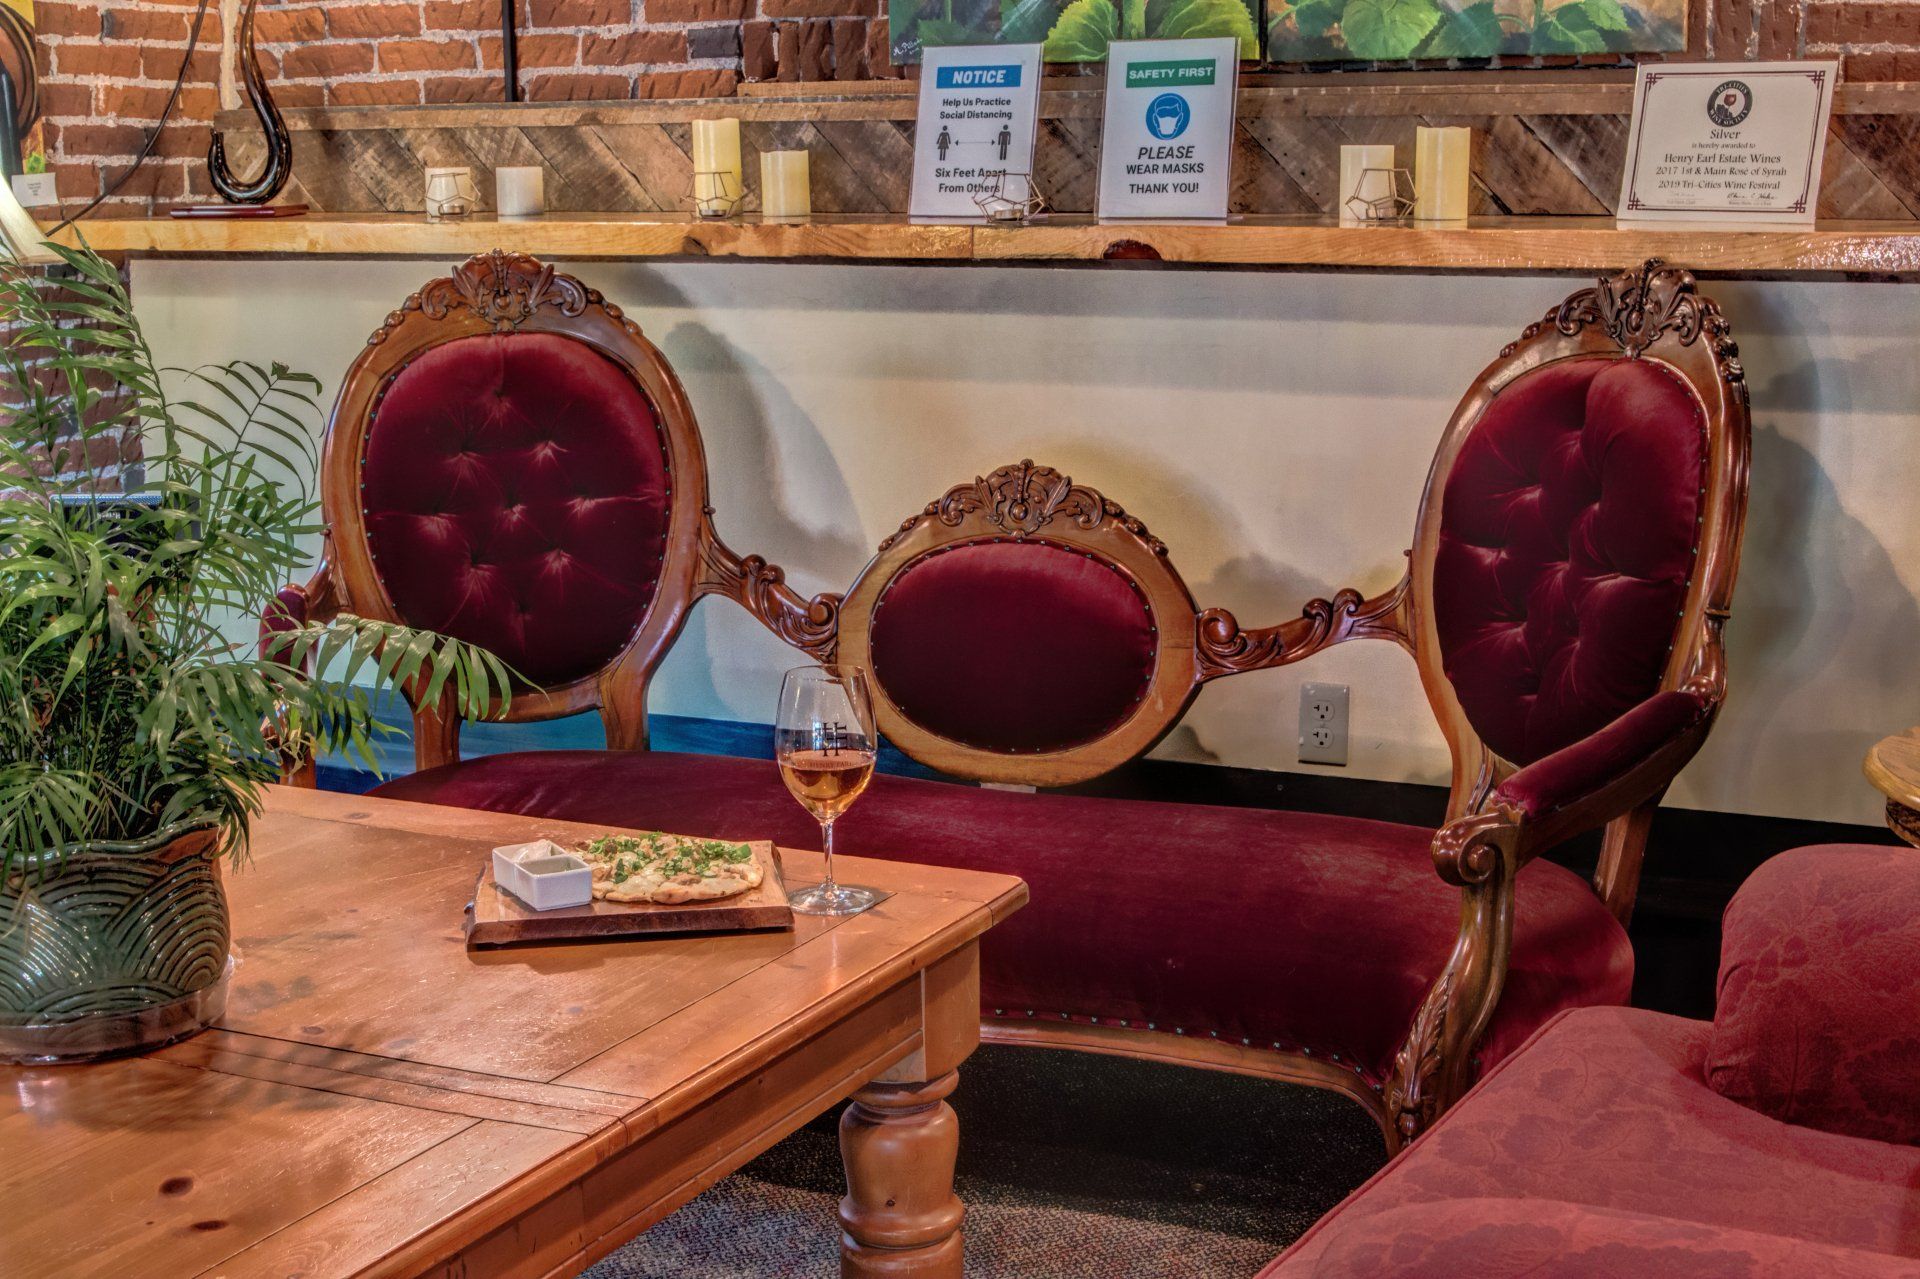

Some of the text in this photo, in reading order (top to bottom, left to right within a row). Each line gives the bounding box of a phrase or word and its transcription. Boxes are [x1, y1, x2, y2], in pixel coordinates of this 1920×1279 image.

[952, 69, 1006, 84] NOTICE
[1129, 66, 1213, 79] SAFETY FIRST
[942, 97, 1011, 108] Help Us Practice
[940, 110, 1012, 120] Social Distancing
[1710, 129, 1741, 140] Silver
[1138, 146, 1195, 160] PLEASE
[1664, 153, 1782, 164] Henry Earl Estate Wines
[935, 168, 951, 178] Six
[953, 168, 975, 178] Feet
[1126, 163, 1204, 175] WEAR MASKS
[1656, 166, 1678, 175] 2017
[1681, 166, 1693, 175] 1st
[1694, 166, 1702, 175] &
[1703, 167, 1727, 176] Main
[1750, 167, 1761, 176] of
[1761, 168, 1787, 178] Syrah
[938, 183, 1000, 193] From Others
[1129, 182, 1199, 194] THANK YOU!
[1658, 180, 1780, 190] 2019 Tri-Cities Wine Festival
